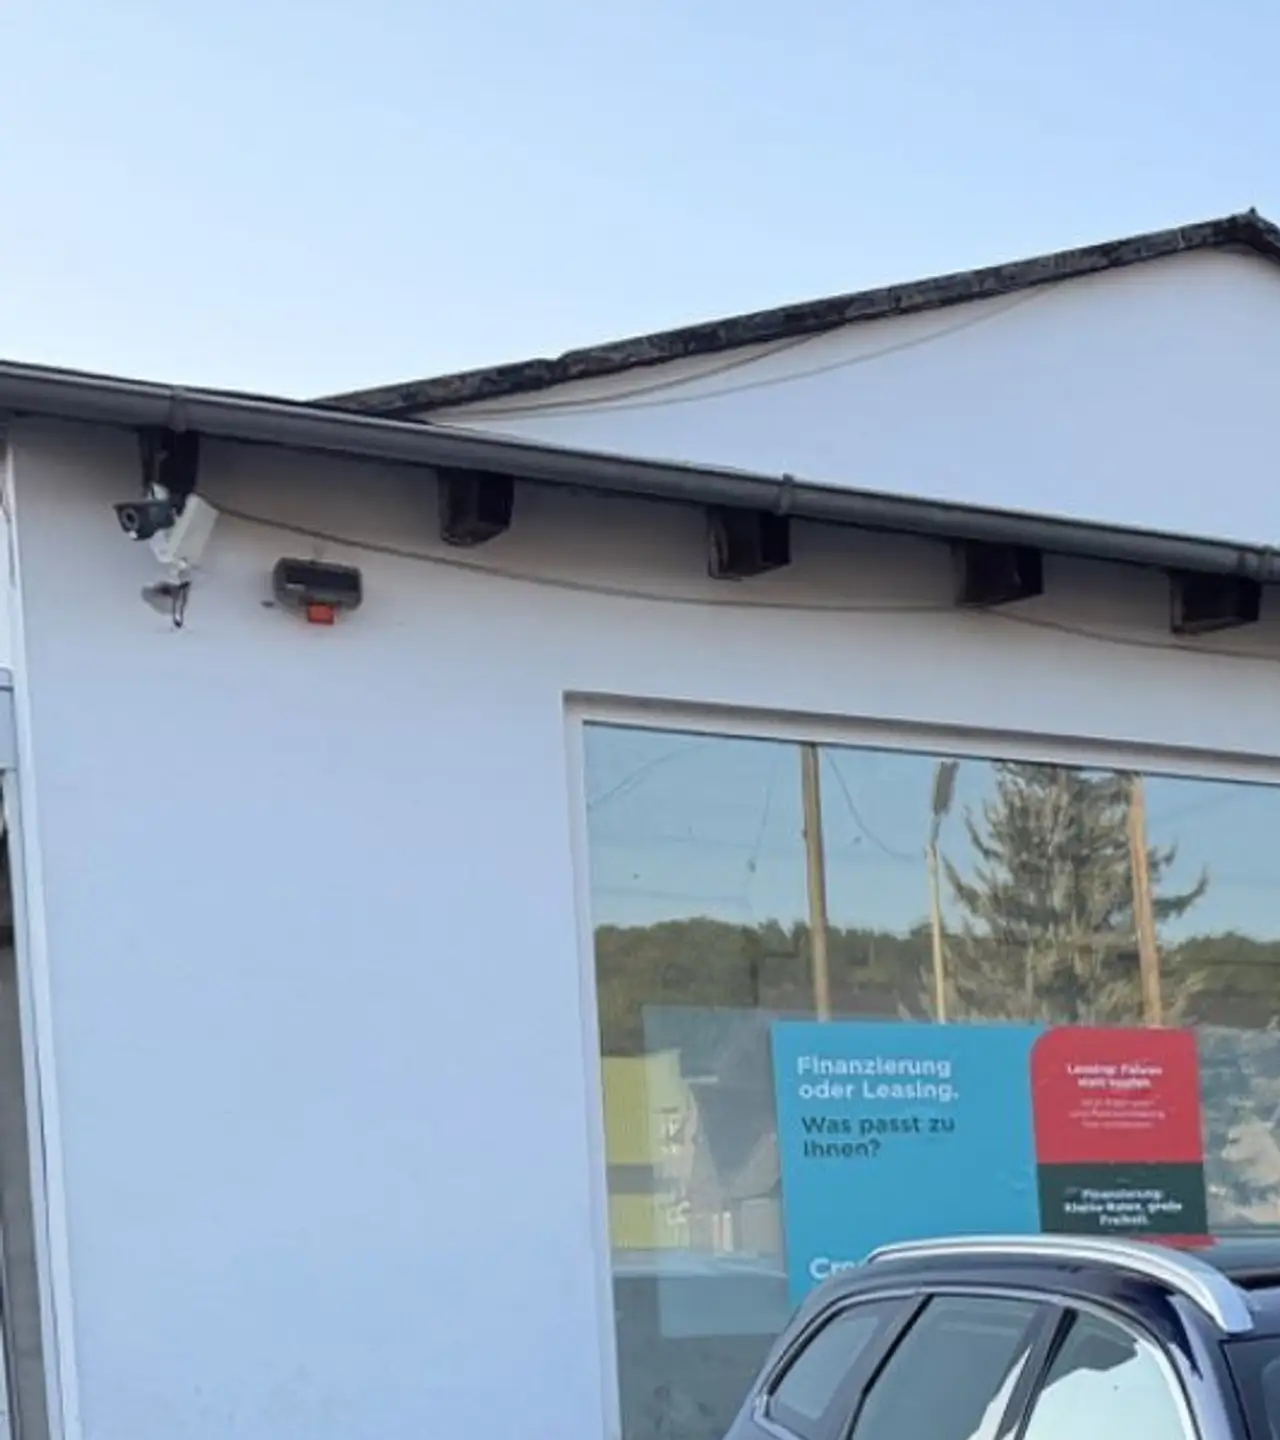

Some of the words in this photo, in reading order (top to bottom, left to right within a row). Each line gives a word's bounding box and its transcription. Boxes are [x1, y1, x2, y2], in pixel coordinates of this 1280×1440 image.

[797, 1055, 952, 1079] Finanzierung
[798, 1079, 855, 1099] oder
[863, 1079, 960, 1102] Leasing.
[802, 1116, 852, 1134] Was
[859, 1116, 920, 1137] passt
[928, 1117, 956, 1133] zu
[803, 1138, 882, 1158] Ihnen?
